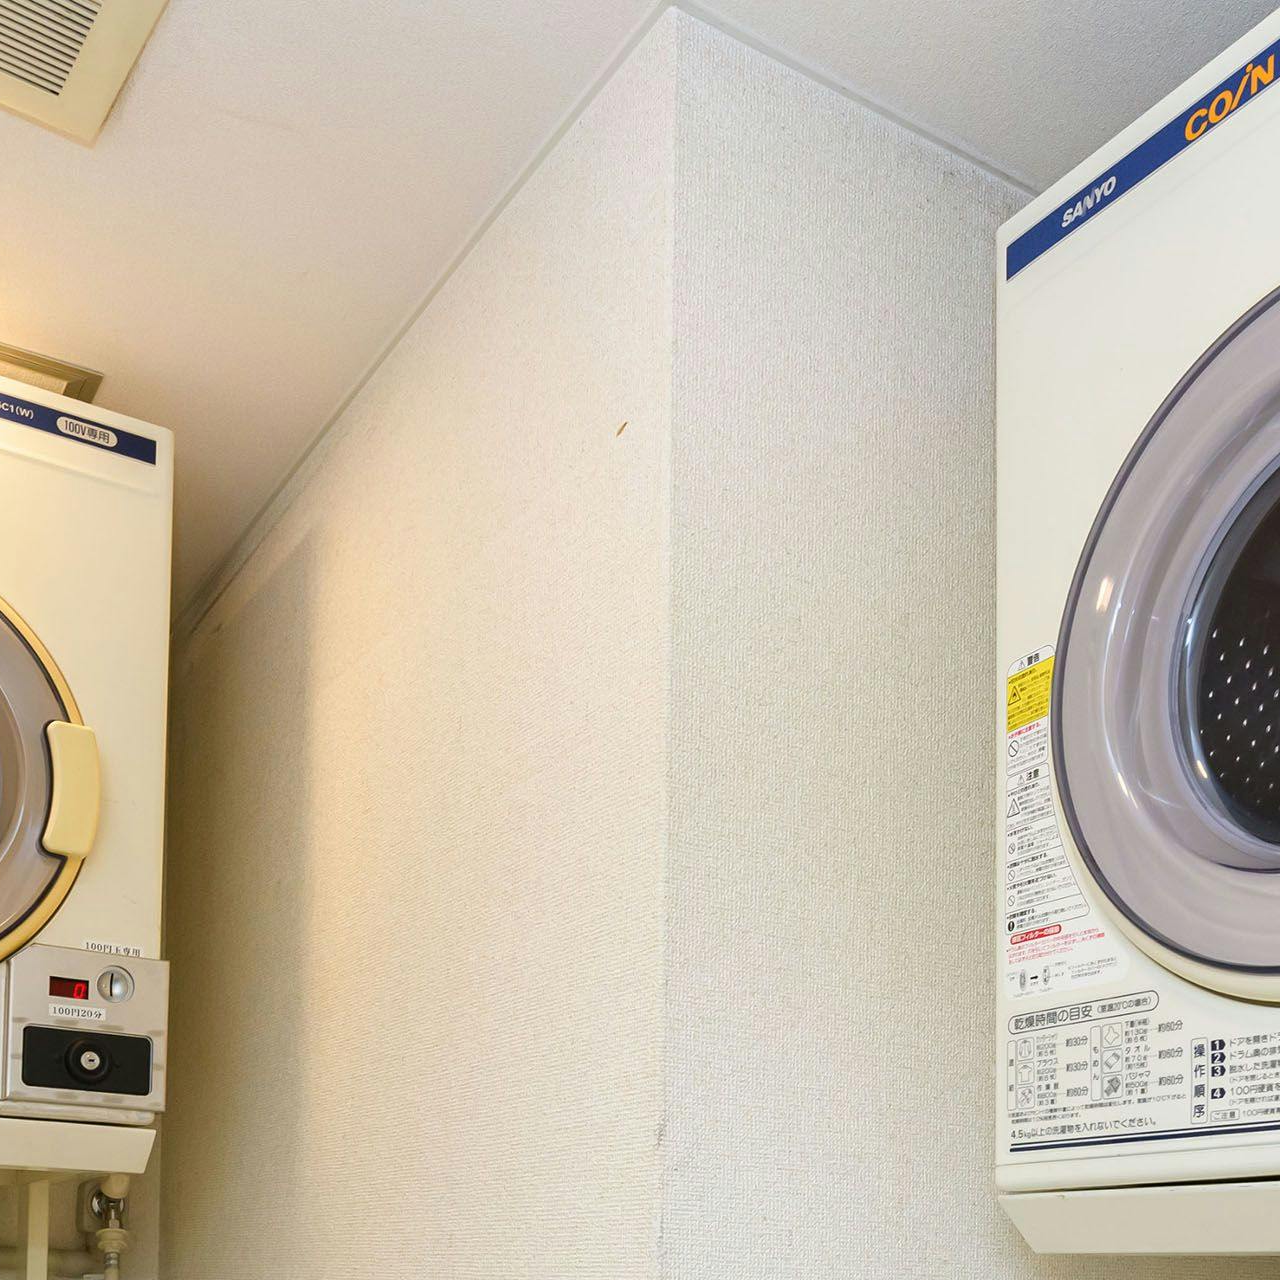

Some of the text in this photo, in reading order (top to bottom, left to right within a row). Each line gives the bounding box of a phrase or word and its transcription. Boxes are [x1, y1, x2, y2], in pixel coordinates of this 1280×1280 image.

[1061, 176, 1116, 229] SANYO
[64, 419, 110, 444] 100V専用
[1025, 768, 1039, 780] 注意
[73, 984, 86, 998] 0
[1014, 1008, 1092, 1030] 乾燥時間の目安
[1192, 1044, 1206, 1119] 操作順序
[1011, 1117, 1156, 1139] 4.5kg以上の洗濯物を入れないでください。
